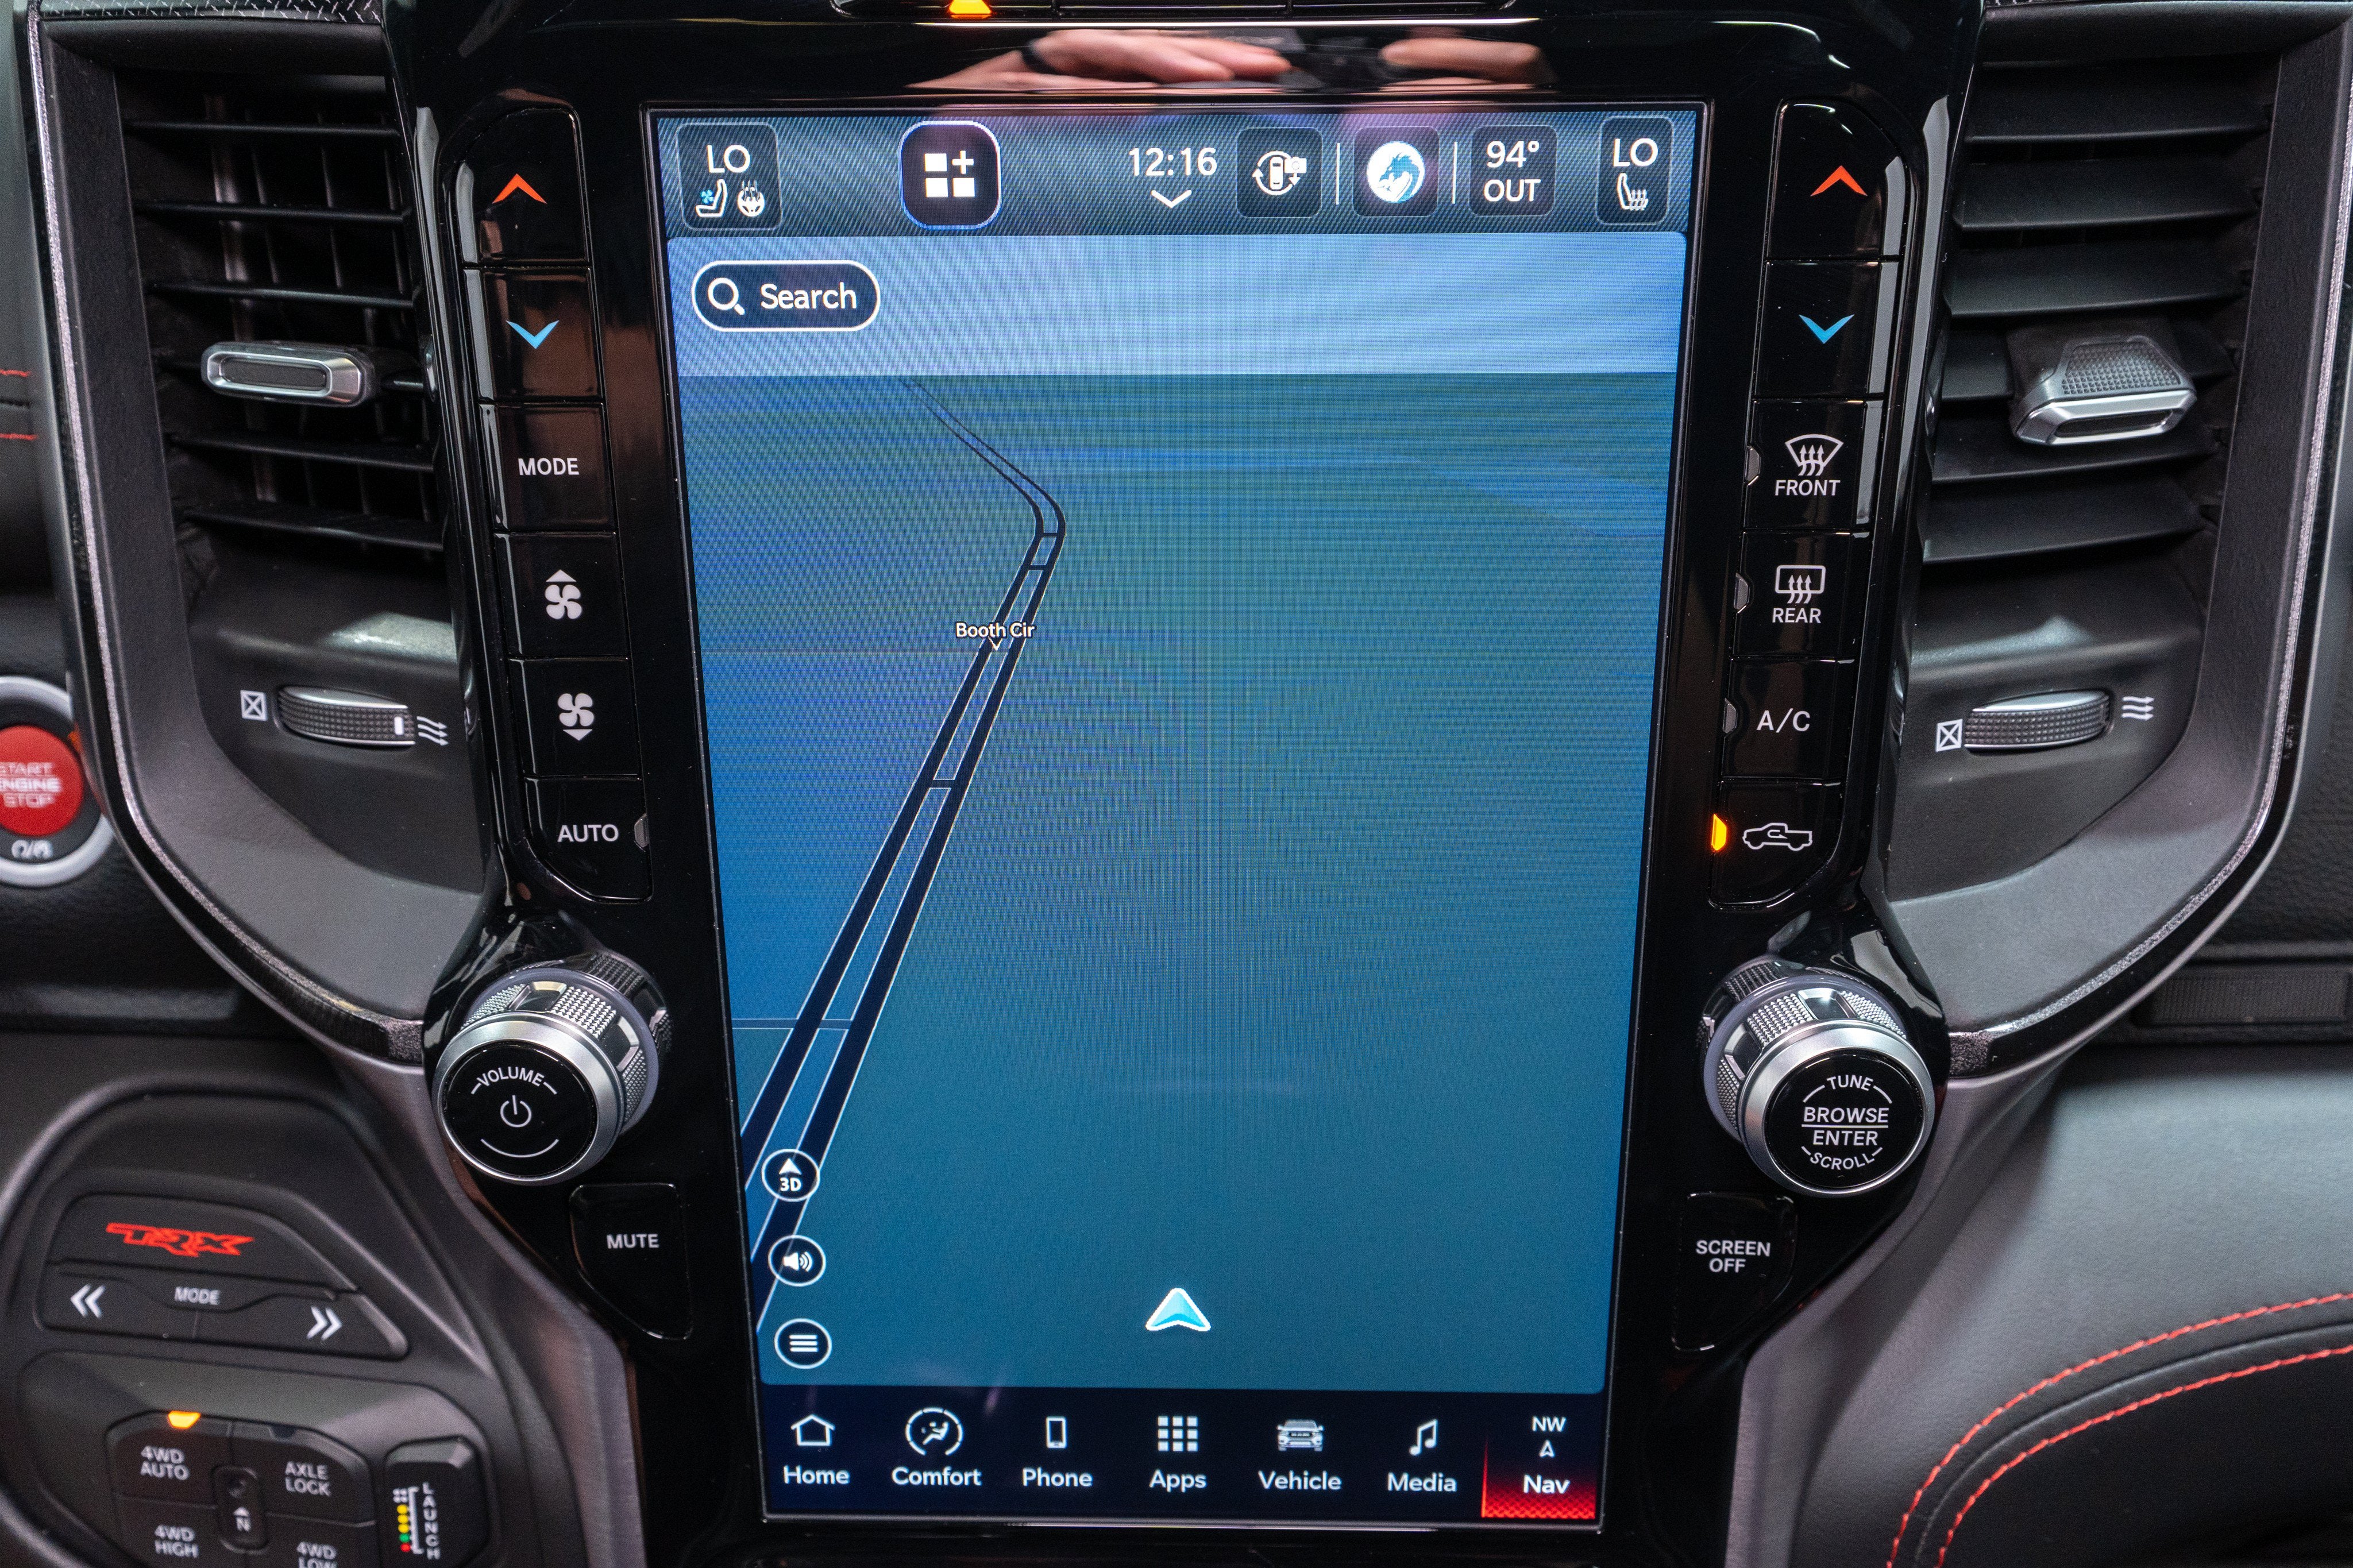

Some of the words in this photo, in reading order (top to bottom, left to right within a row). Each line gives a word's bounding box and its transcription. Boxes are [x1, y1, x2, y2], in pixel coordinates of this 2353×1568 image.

[707, 144, 751, 173] LO
[1128, 146, 1218, 177] 12:16
[1613, 138, 1658, 167] LO
[1484, 179, 1542, 202] OUT
[761, 281, 857, 310] Search
[518, 457, 580, 476] MODE
[1775, 479, 1841, 496] FRONT
[1772, 607, 1821, 624] REAR
[955, 622, 1006, 638] Booth
[1009, 622, 1035, 638] Cir
[1756, 708, 1810, 733] A/C
[0, 777, 61, 793] NGINE
[3, 793, 54, 808] STOP
[557, 824, 619, 843] AUTO
[477, 1066, 544, 1087] VOLUME
[1827, 1074, 1873, 1091] TUNE
[1803, 1106, 1889, 1123] BROWSE
[1812, 1130, 1878, 1146] ENTER
[1810, 1151, 1874, 1171] SCROLL
[780, 1177, 802, 1192] 3D
[606, 1233, 659, 1249] MUTE
[1695, 1239, 1771, 1257] SCREEN
[1709, 1258, 1746, 1273] OFF
[175, 1287, 220, 1305] MODE
[1532, 1416, 1566, 1432] NW
[141, 1446, 184, 1464] 4WD
[141, 1461, 190, 1481] AUTO
[286, 1461, 328, 1481] AXLE
[783, 1465, 849, 1485] Home
[892, 1466, 981, 1486] Comfort
[1023, 1467, 1092, 1487] Phone
[1149, 1469, 1206, 1492] Apps
[1257, 1470, 1341, 1490] Vehicle
[286, 1477, 331, 1497] LOCK
[1387, 1472, 1456, 1492] Media
[1523, 1474, 1570, 1494] Nav
[155, 1524, 195, 1542] 4WD
[155, 1540, 198, 1558] HIGH
[296, 1542, 337, 1560] 4WD
[298, 1557, 337, 1568] LOW
